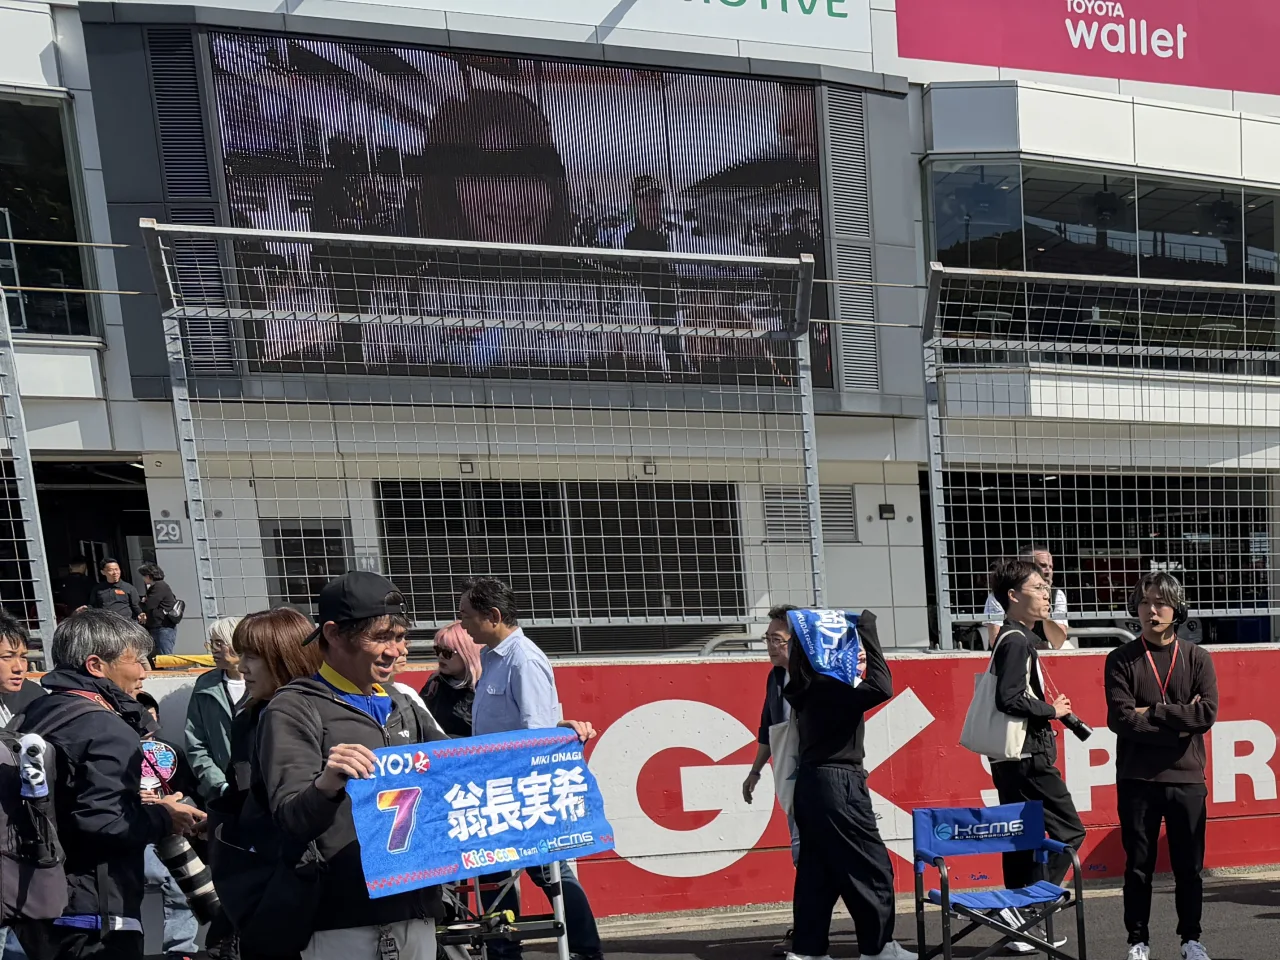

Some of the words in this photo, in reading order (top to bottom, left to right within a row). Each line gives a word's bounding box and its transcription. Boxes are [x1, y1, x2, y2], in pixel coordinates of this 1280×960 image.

[1065, 16, 1187, 59] wallet
[157, 523, 180, 541] 29
[531, 755, 550, 767] MIKI
[443, 765, 588, 842] 翁長実希
[376, 786, 422, 854] 7
[955, 819, 1024, 836] KCMG
[519, 847, 538, 856] Team
[548, 831, 594, 848] KCMG
